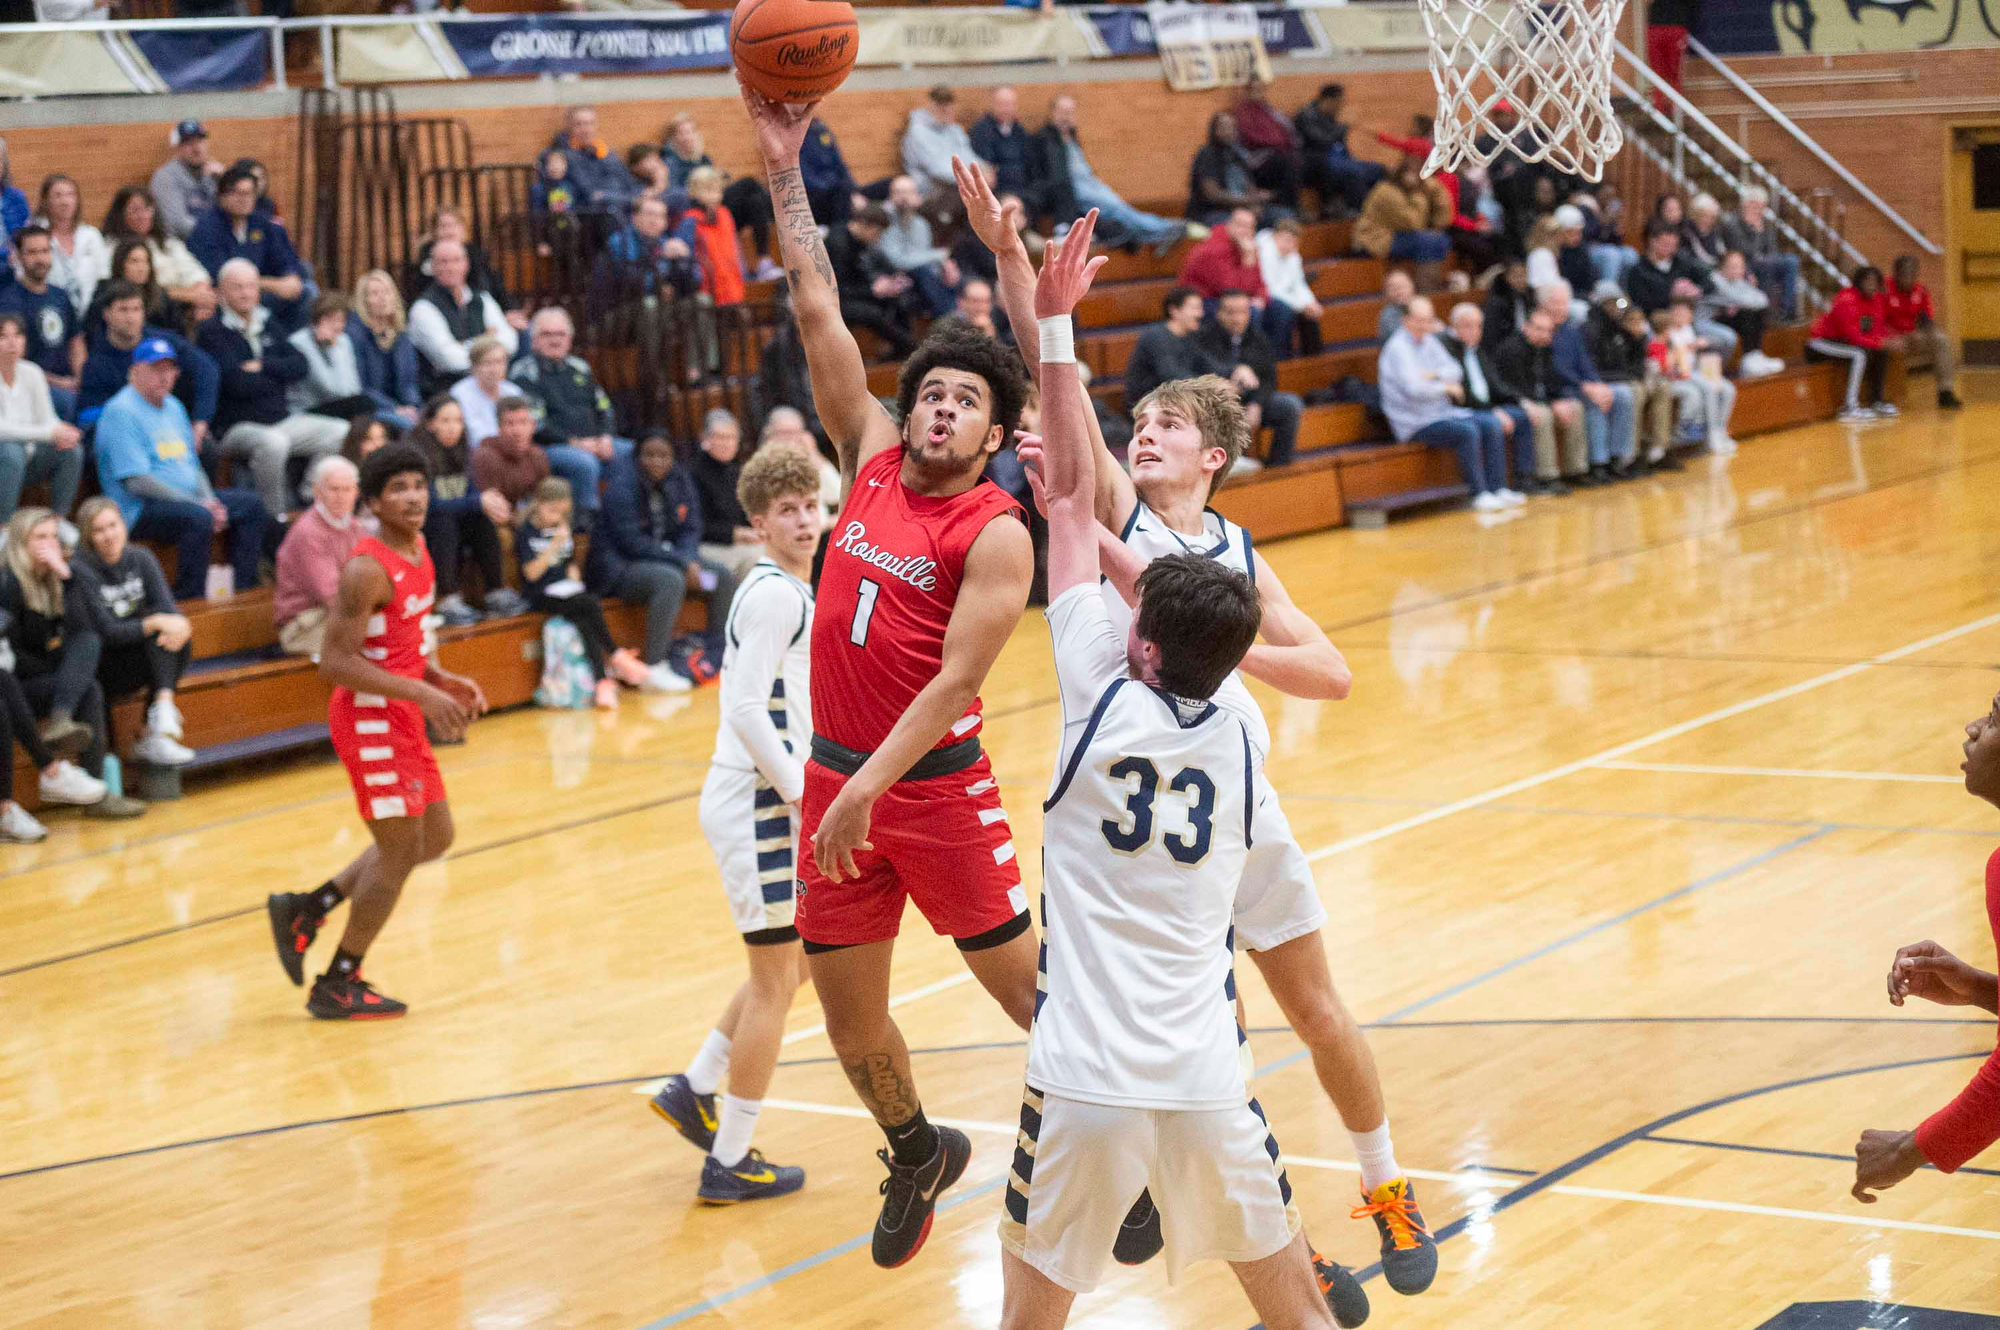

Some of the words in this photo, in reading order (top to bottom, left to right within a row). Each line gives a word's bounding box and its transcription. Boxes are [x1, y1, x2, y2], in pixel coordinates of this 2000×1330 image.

[777, 31, 850, 66] Rawlings
[835, 520, 937, 593] Roseville
[850, 576, 881, 648] 1
[1168, 692, 1209, 709] RMOUR
[1099, 754, 1220, 871] 33
